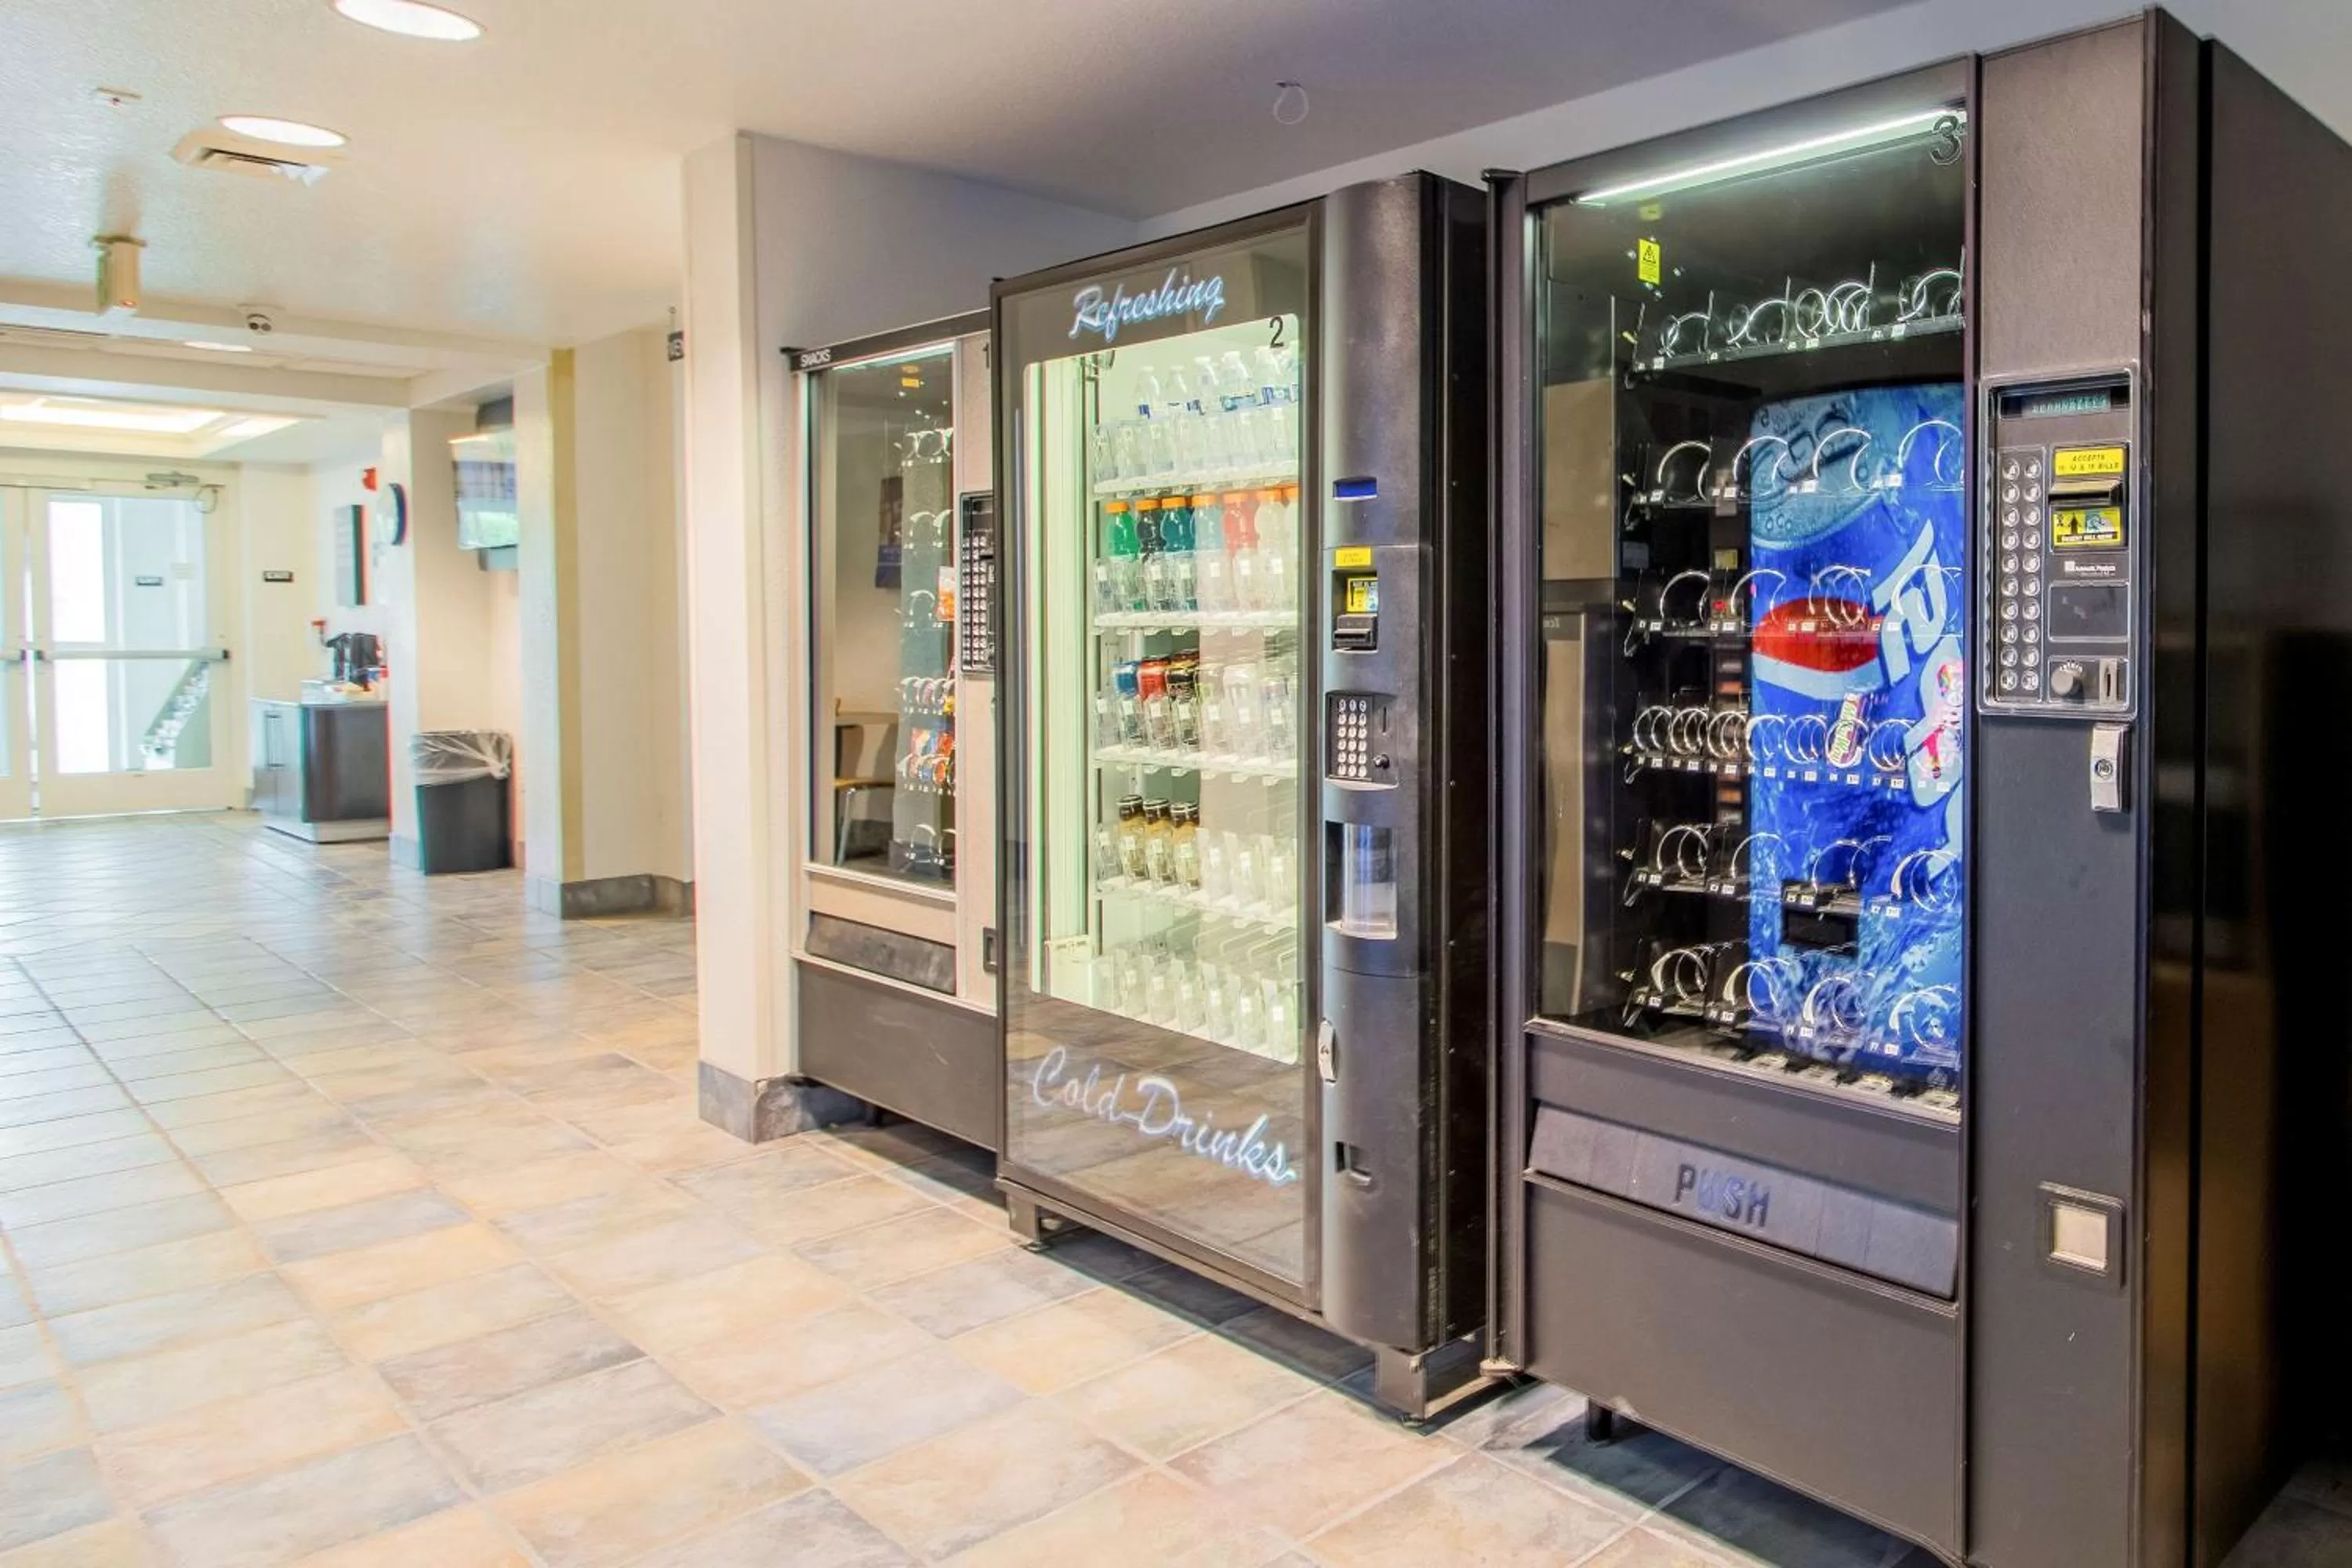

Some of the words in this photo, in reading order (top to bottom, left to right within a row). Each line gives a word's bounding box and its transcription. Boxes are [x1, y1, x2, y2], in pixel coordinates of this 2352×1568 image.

[1930, 115, 1962, 164] 3
[1068, 267, 1225, 342] Refreshing
[1269, 316, 1285, 349] 2
[800, 348, 831, 368] SNACKS
[1032, 1045, 1129, 1122] Cold
[1137, 1075, 1298, 1186] Drinks
[1673, 1163, 1771, 1228] PUSH
